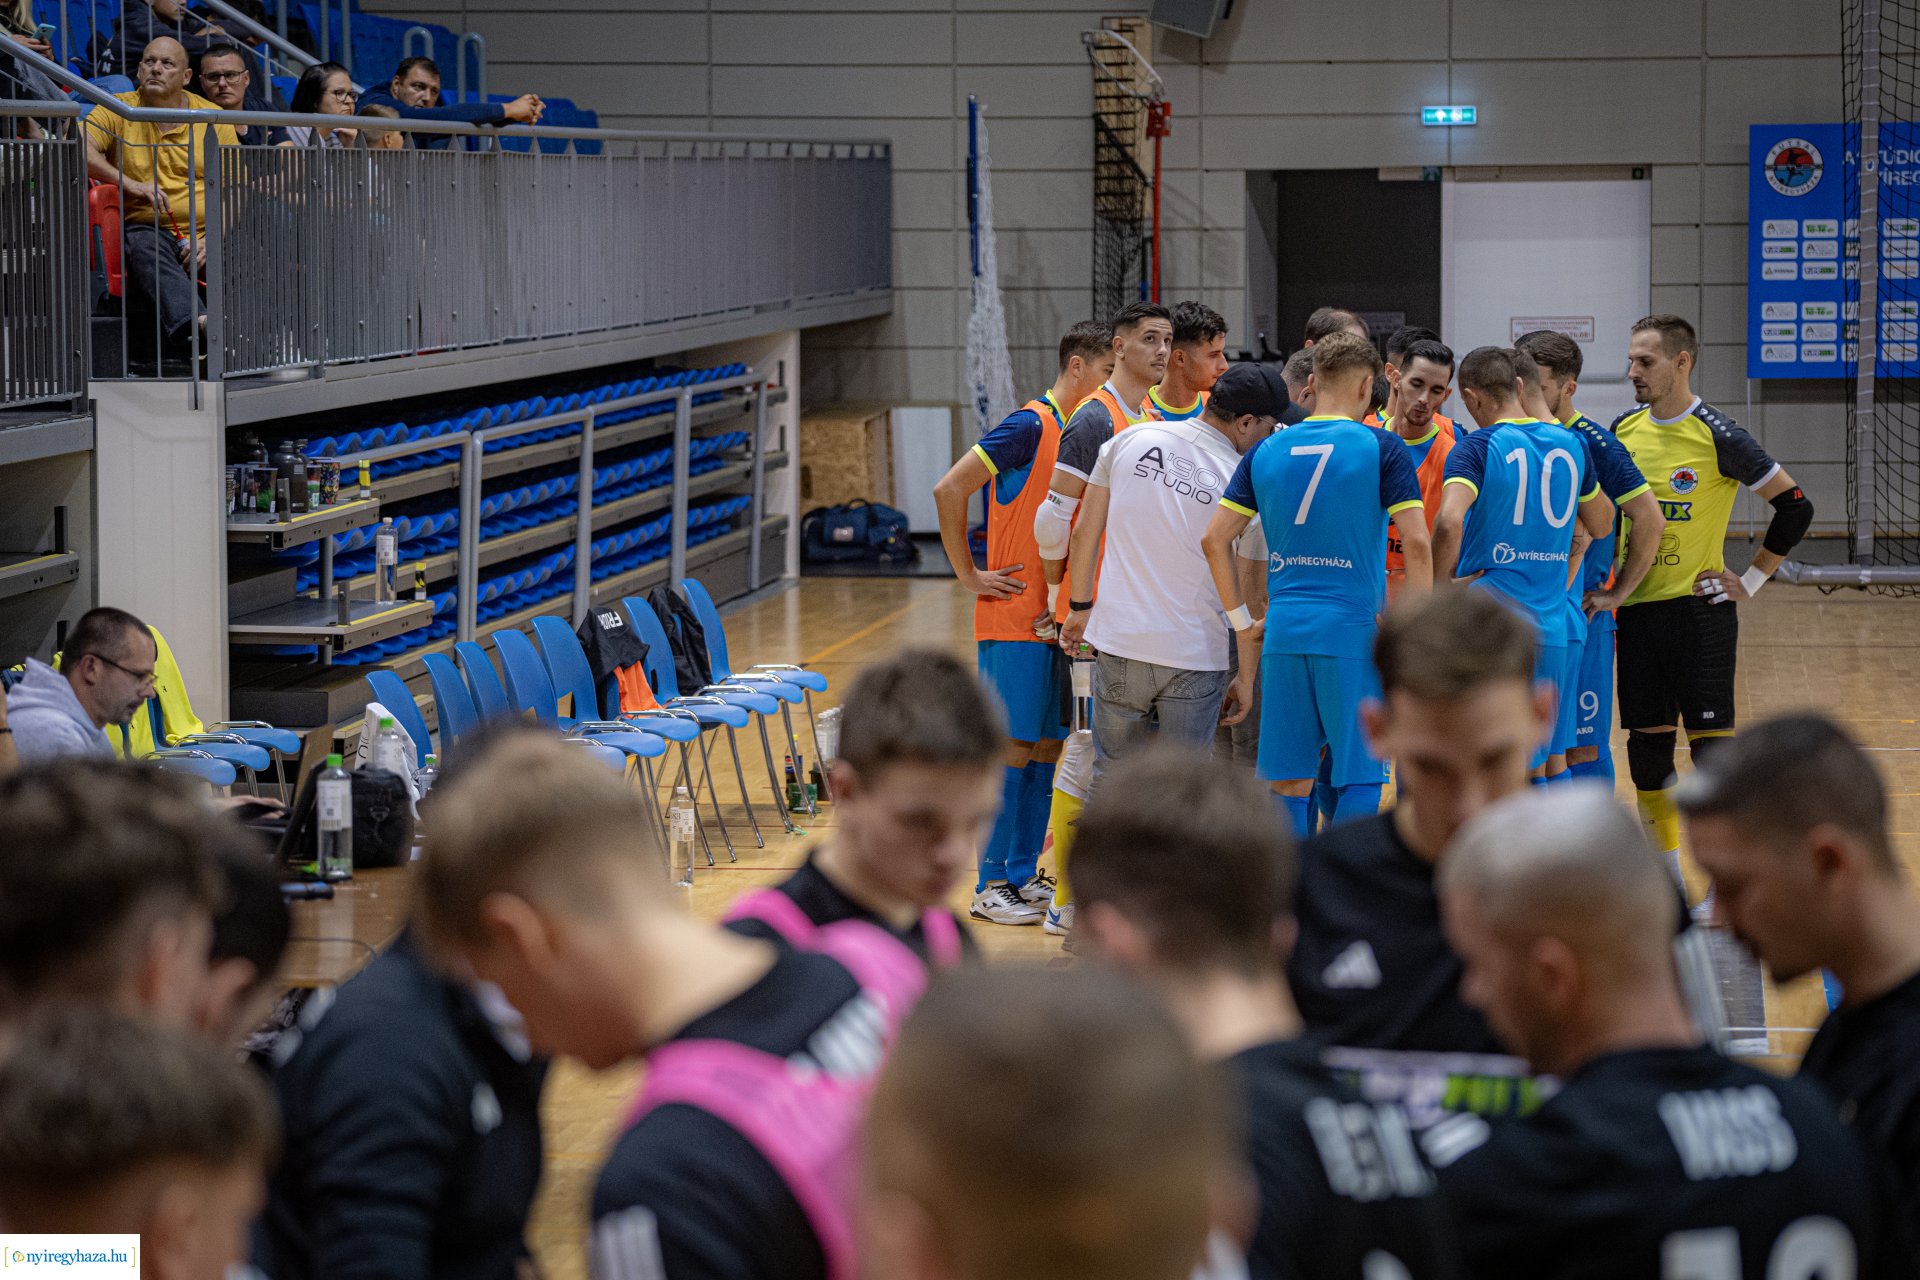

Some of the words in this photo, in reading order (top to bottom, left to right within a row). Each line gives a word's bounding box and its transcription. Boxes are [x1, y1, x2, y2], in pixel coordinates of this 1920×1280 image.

[1133, 463, 1213, 505] STUDIO
[1290, 444, 1335, 525] 7
[1505, 448, 1579, 529] 10
[1286, 554, 1353, 569] NYÍREGYHÁZA
[1579, 690, 1600, 721] 9
